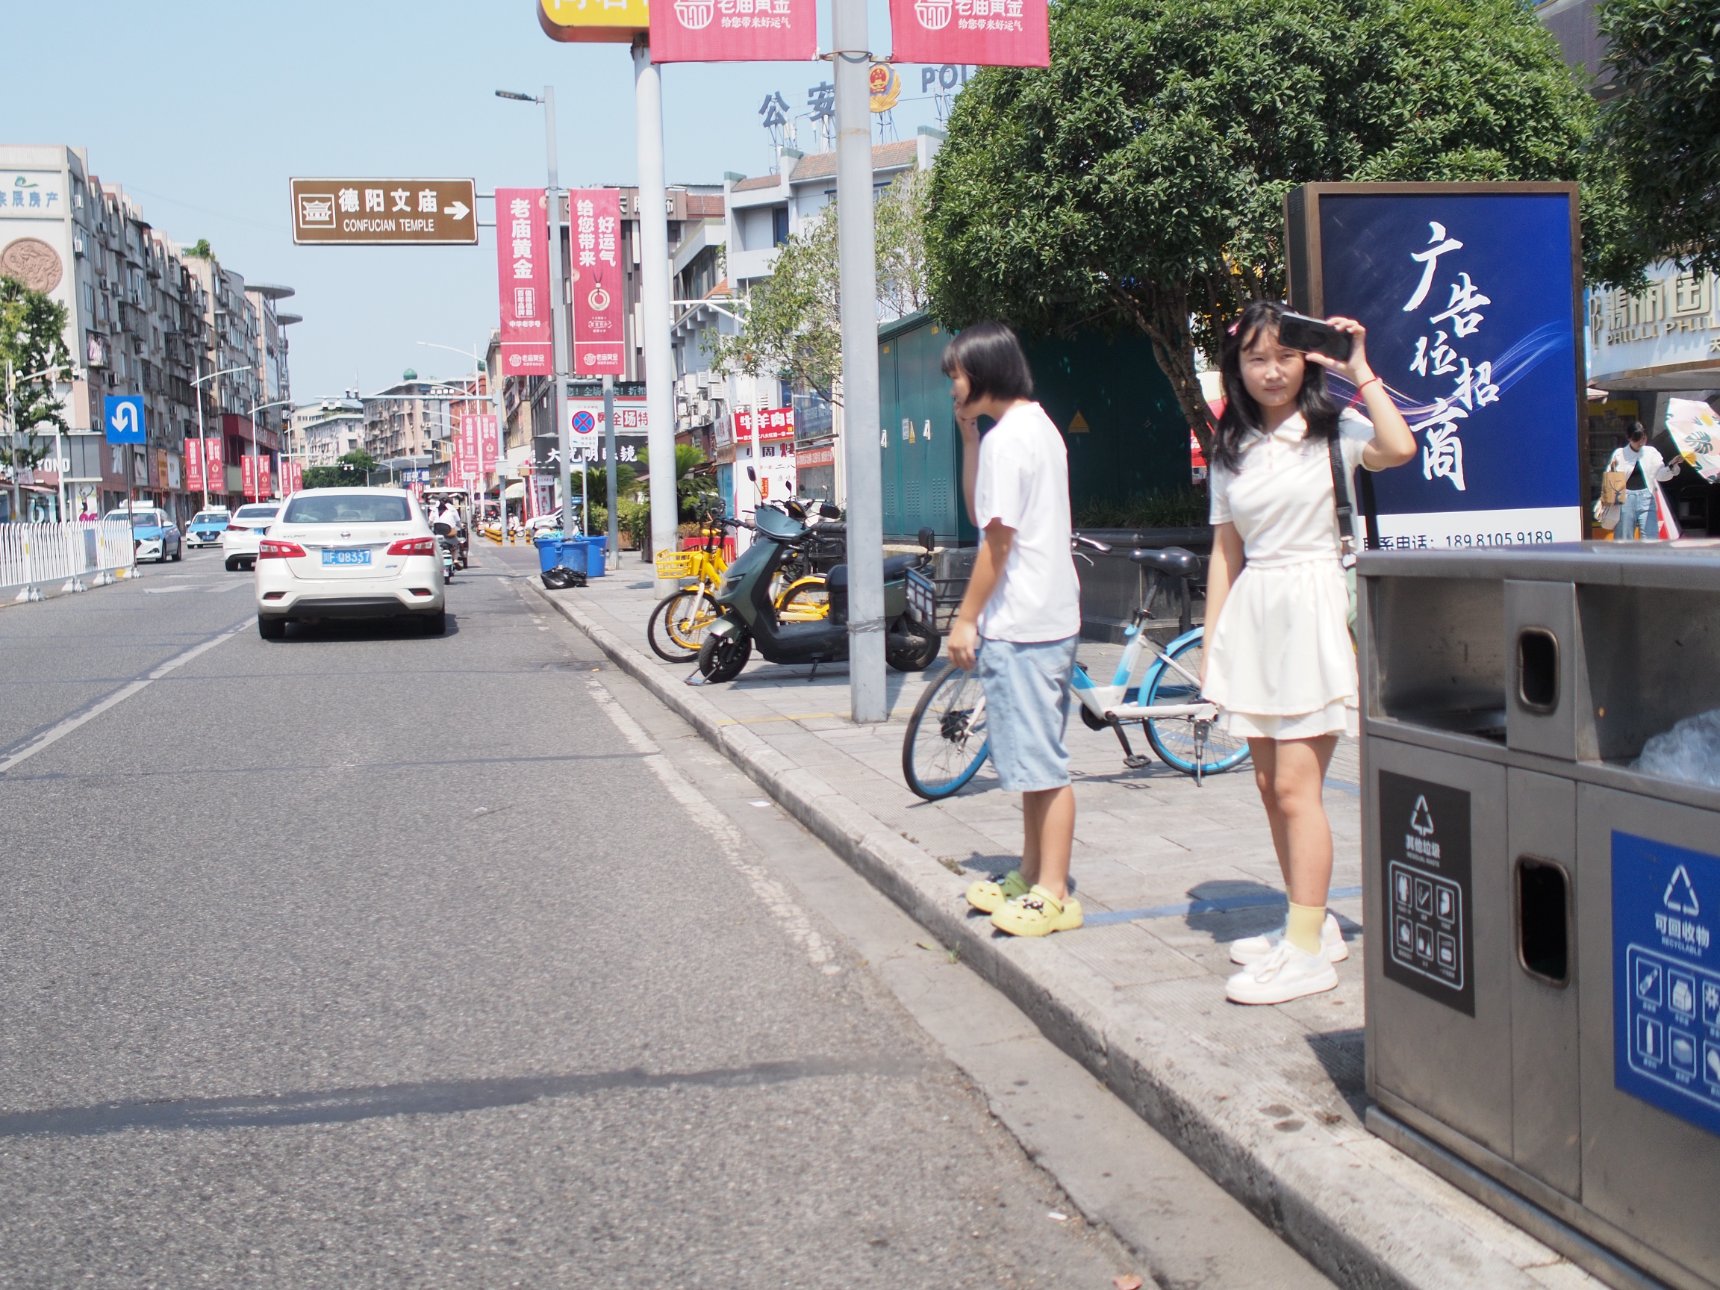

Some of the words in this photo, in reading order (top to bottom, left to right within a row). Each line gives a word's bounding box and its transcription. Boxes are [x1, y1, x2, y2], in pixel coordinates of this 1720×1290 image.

[721, 16, 792, 28] 给您带来好运气
[958, 18, 1024, 32] 给您带来好运气
[758, 81, 836, 128] 公安
[338, 188, 438, 213] 德阳文庙
[343, 219, 396, 232] CONFUCIAN
[400, 219, 435, 231] TEMPLE
[510, 198, 533, 279] 老庙黄金
[576, 199, 596, 267] 给您带来
[597, 216, 616, 267] 好运气
[1405, 834, 1440, 859] 其他垃圾
[1655, 912, 1710, 949] 可回收物
